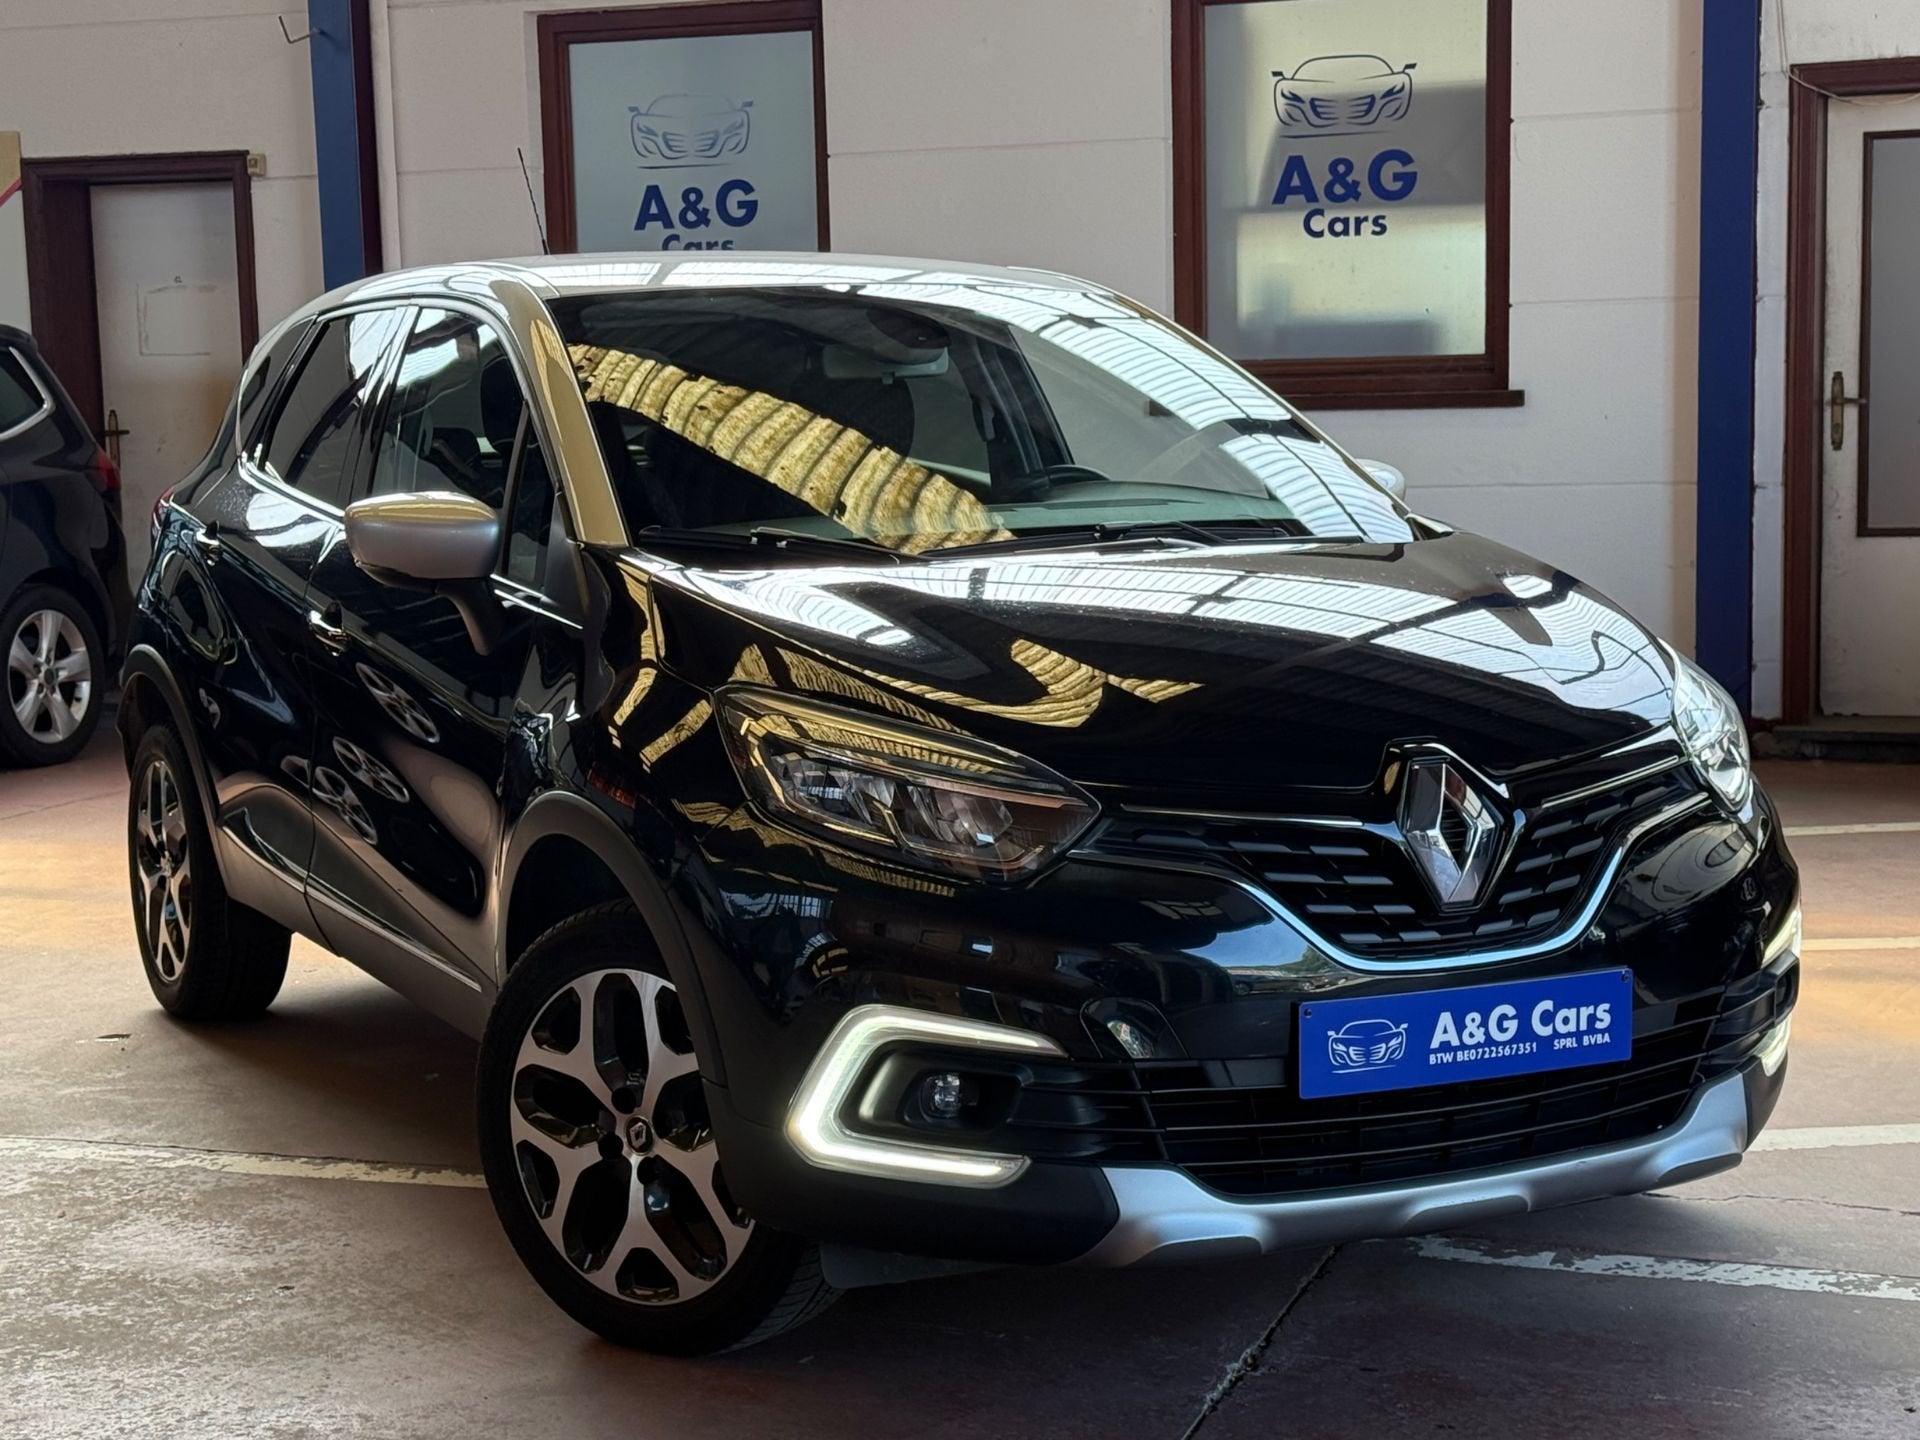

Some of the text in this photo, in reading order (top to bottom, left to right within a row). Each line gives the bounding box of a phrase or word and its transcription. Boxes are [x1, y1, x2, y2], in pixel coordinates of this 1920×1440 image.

[1272, 149, 1418, 205] A&G
[634, 179, 759, 231] A&G
[1303, 208, 1388, 238] Cars
[1429, 1032, 1611, 1065] BTW BE0722567351 SPRL BVBA
[1430, 1000, 1612, 1049] A&G Cars
